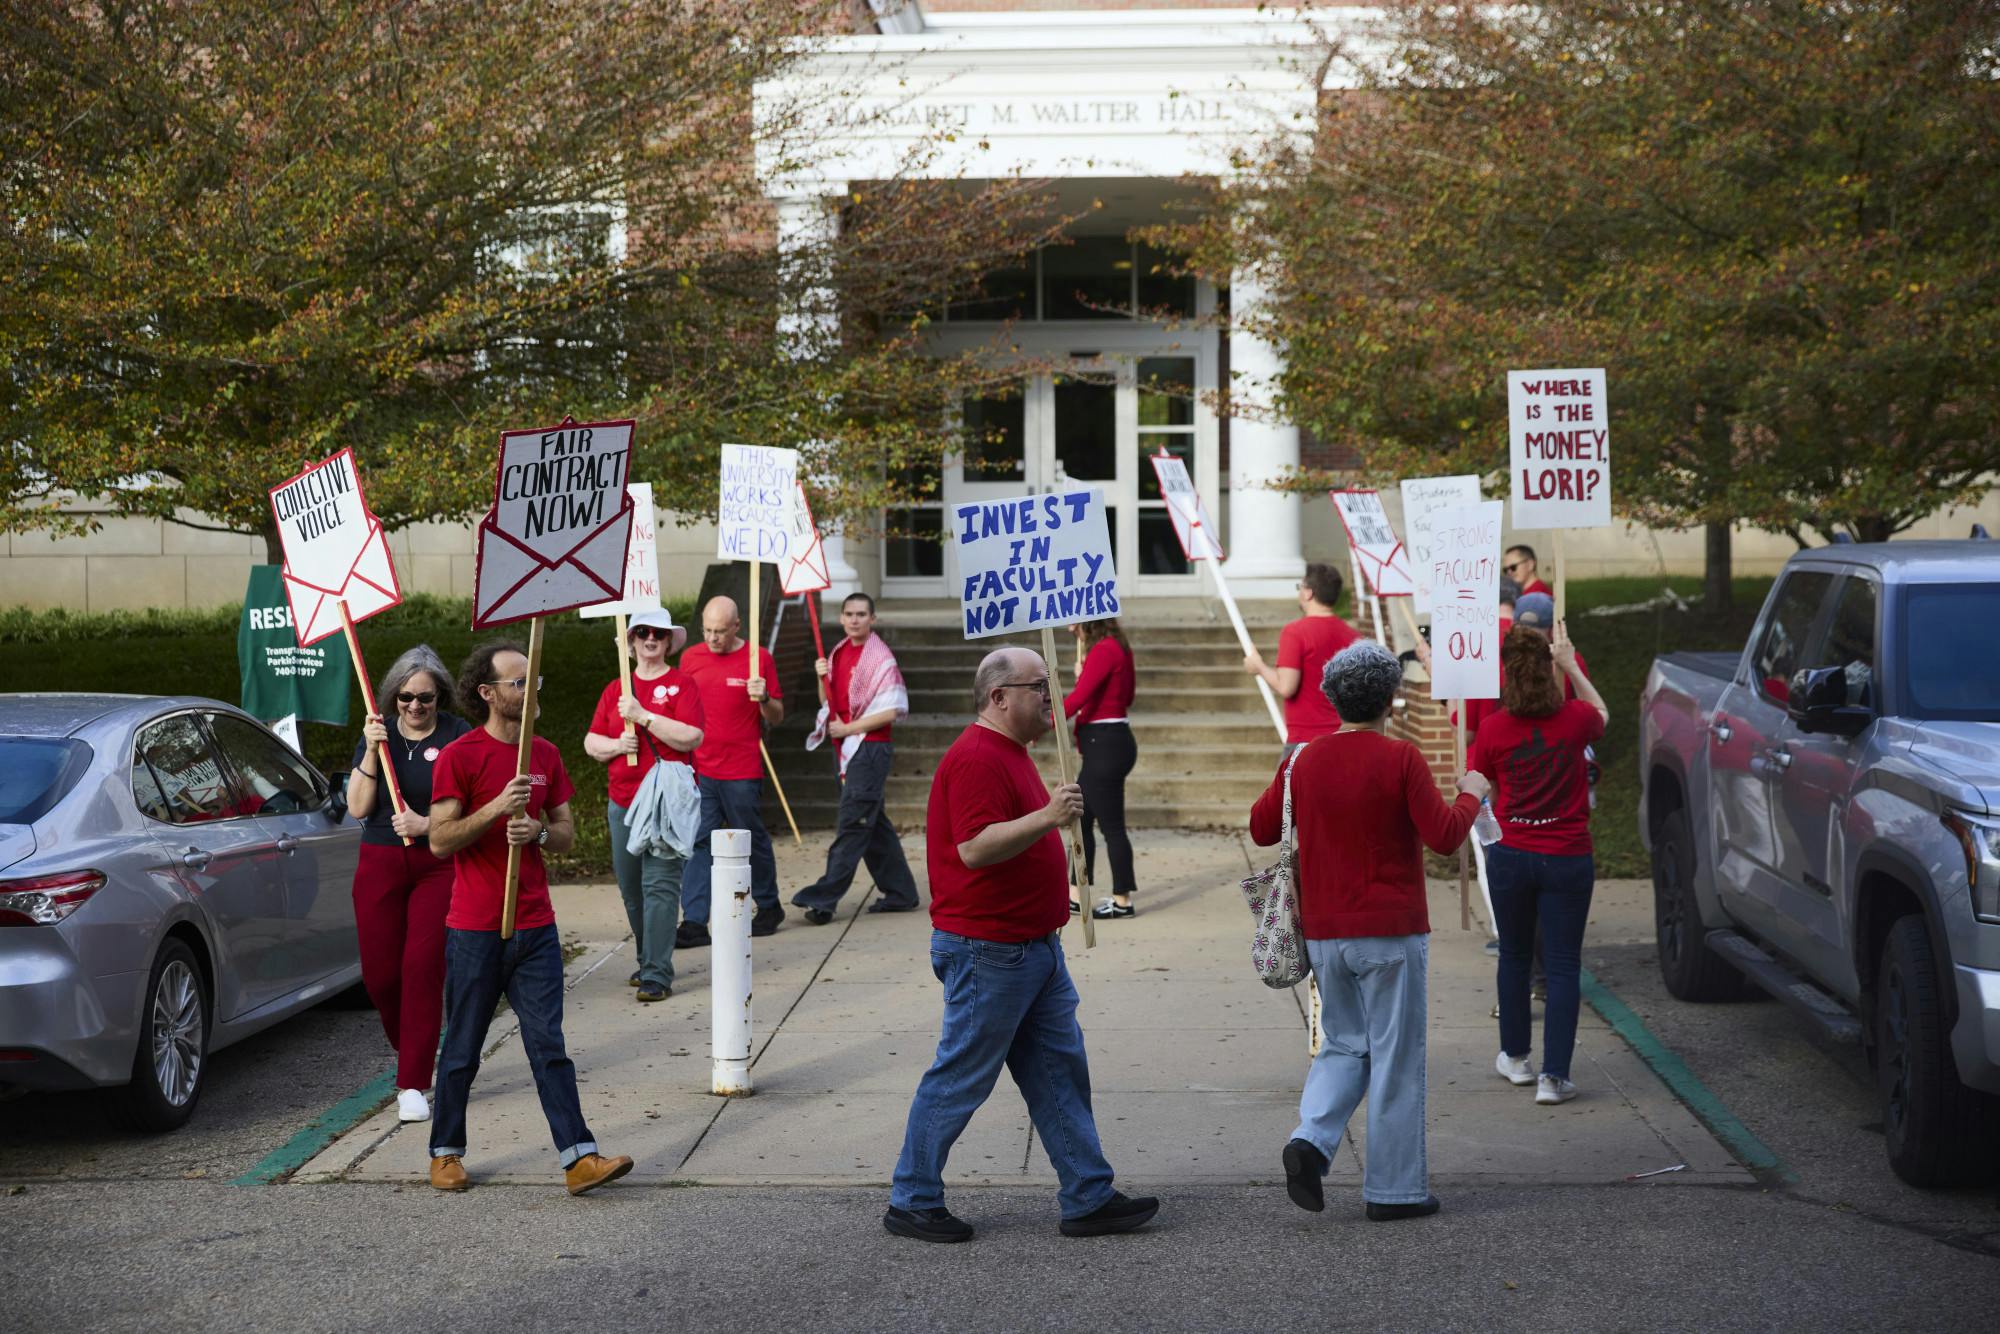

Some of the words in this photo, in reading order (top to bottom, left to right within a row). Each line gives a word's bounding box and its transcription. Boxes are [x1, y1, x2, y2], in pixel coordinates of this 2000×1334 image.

[992, 103, 1018, 124] M.
[1033, 102, 1140, 123] WALTER
[1159, 101, 1231, 121] HALL
[1521, 379, 1592, 396] WHERE
[1526, 404, 1541, 420] IS
[1553, 403, 1593, 422] THE
[540, 429, 593, 460] FAIR
[737, 447, 775, 467] THIS
[1525, 429, 1608, 464] MONEY,
[275, 456, 355, 521] COLLECTIVE
[502, 449, 628, 501] CONTRACT
[722, 464, 794, 490] UNIVERSITY
[1522, 468, 1600, 501] LORI?
[722, 484, 782, 506] WORKS
[296, 496, 346, 542] VOICE
[524, 490, 604, 539] NOW!
[722, 504, 784, 528] BECAUSE
[957, 492, 1091, 544] INVEST
[721, 527, 752, 555] WE
[758, 528, 788, 558] DO
[1009, 536, 1051, 566] IN
[1435, 520, 1496, 552] STRONG
[964, 552, 1104, 601] FACULTY
[1434, 555, 1497, 587] FACULTY
[249, 605, 295, 630] RESE
[966, 596, 1019, 634] NOT
[1029, 580, 1119, 623] LAWYERS
[1435, 604, 1497, 627] STRONG
